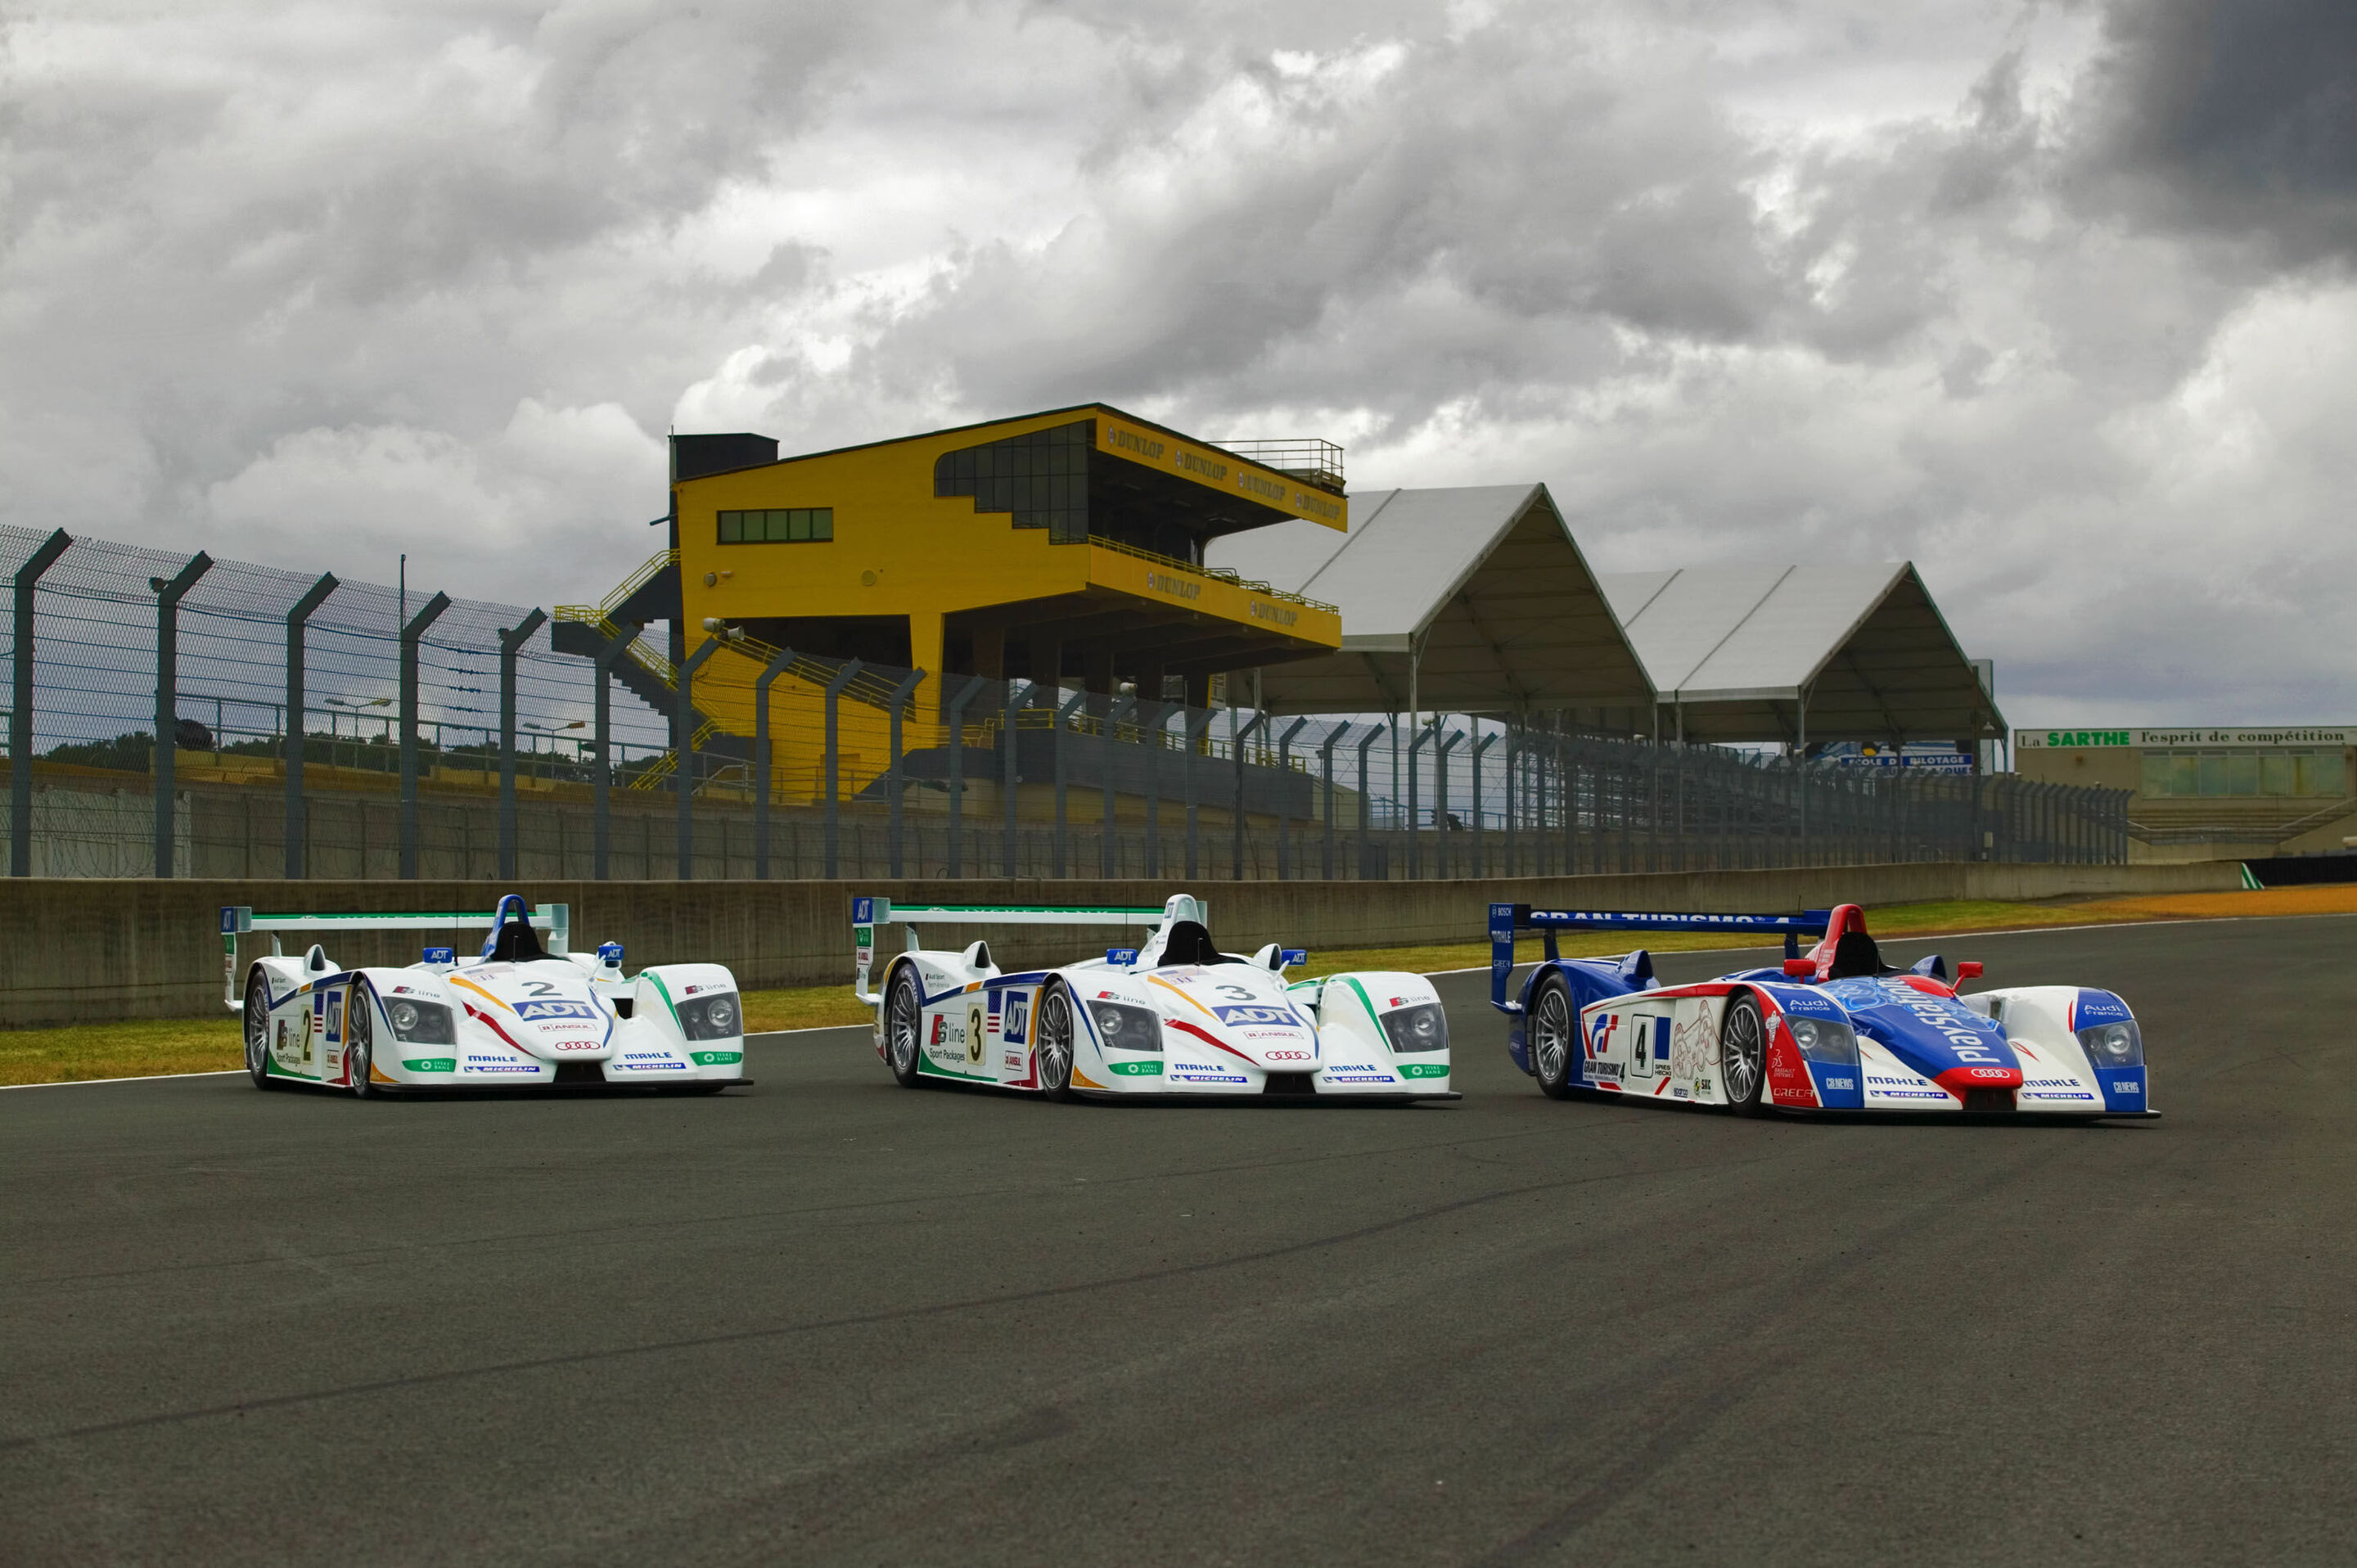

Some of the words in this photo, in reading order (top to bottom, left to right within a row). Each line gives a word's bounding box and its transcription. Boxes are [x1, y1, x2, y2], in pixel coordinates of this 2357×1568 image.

[1117, 430, 1164, 460] DUNLOP
[1184, 453, 1227, 481] DUNLOP
[1246, 474, 1286, 501] DUNLOP
[1303, 495, 1341, 520] DUNLOP
[1156, 574, 1201, 601] DUNLOP
[1257, 602, 1297, 627] DUNLOP
[2021, 735, 2040, 746] La
[2048, 732, 2129, 746] SARTHE
[2142, 731, 2202, 745] l'esprit
[2209, 731, 2229, 742] de
[2238, 730, 2345, 745] compétition
[431, 950, 448, 959] ADT
[607, 948, 620, 958] ADT
[1114, 951, 1133, 961] ADT
[1292, 953, 1305, 962] ADT
[521, 981, 562, 996] 2
[1215, 985, 1257, 1001] 3
[1123, 995, 1146, 1005] line
[1410, 994, 1431, 1003] line
[327, 1002, 341, 1035] ADT
[522, 1003, 588, 1020] ADT
[1005, 1000, 1028, 1036] ADT
[1225, 1007, 1294, 1024] ADT
[289, 1028, 300, 1048] line
[303, 1009, 311, 1061] 2
[949, 1024, 965, 1043] line
[971, 1008, 981, 1061] 3
[1635, 1022, 1647, 1070] 4
[624, 1052, 673, 1060] MAHLE
[929, 1048, 943, 1060] Sport
[944, 1049, 965, 1063] Packages
[1329, 1064, 1377, 1072] MAHLE
[1620, 1062, 1625, 1082] 4
[1866, 1076, 1927, 1086] MAHLE
[1773, 1088, 1814, 1097] ORECA
